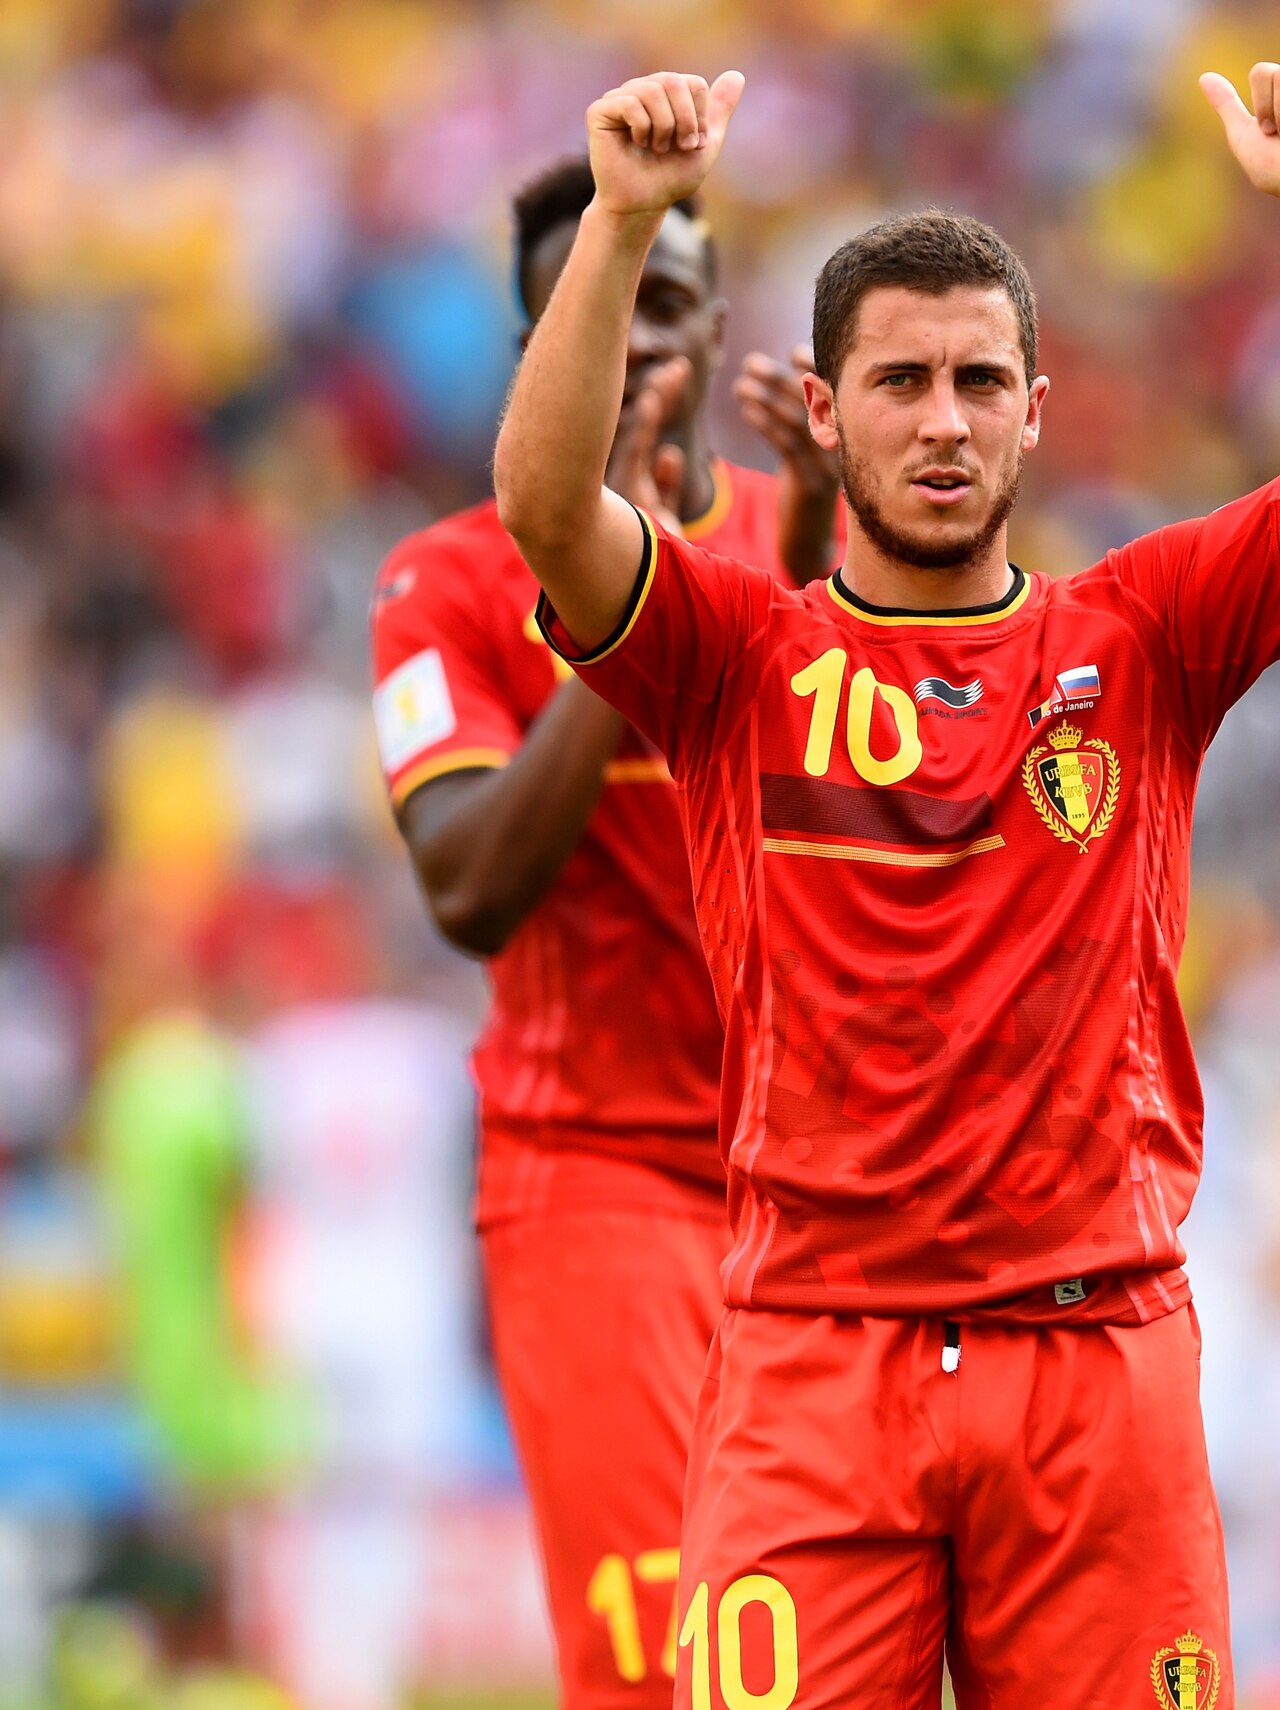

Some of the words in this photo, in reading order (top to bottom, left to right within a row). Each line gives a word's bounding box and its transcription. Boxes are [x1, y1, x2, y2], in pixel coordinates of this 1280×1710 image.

[790, 648, 922, 786] 10
[1053, 704, 1063, 714] de
[1064, 700, 1094, 711] Janeiro
[679, 1574, 798, 1710] 10
